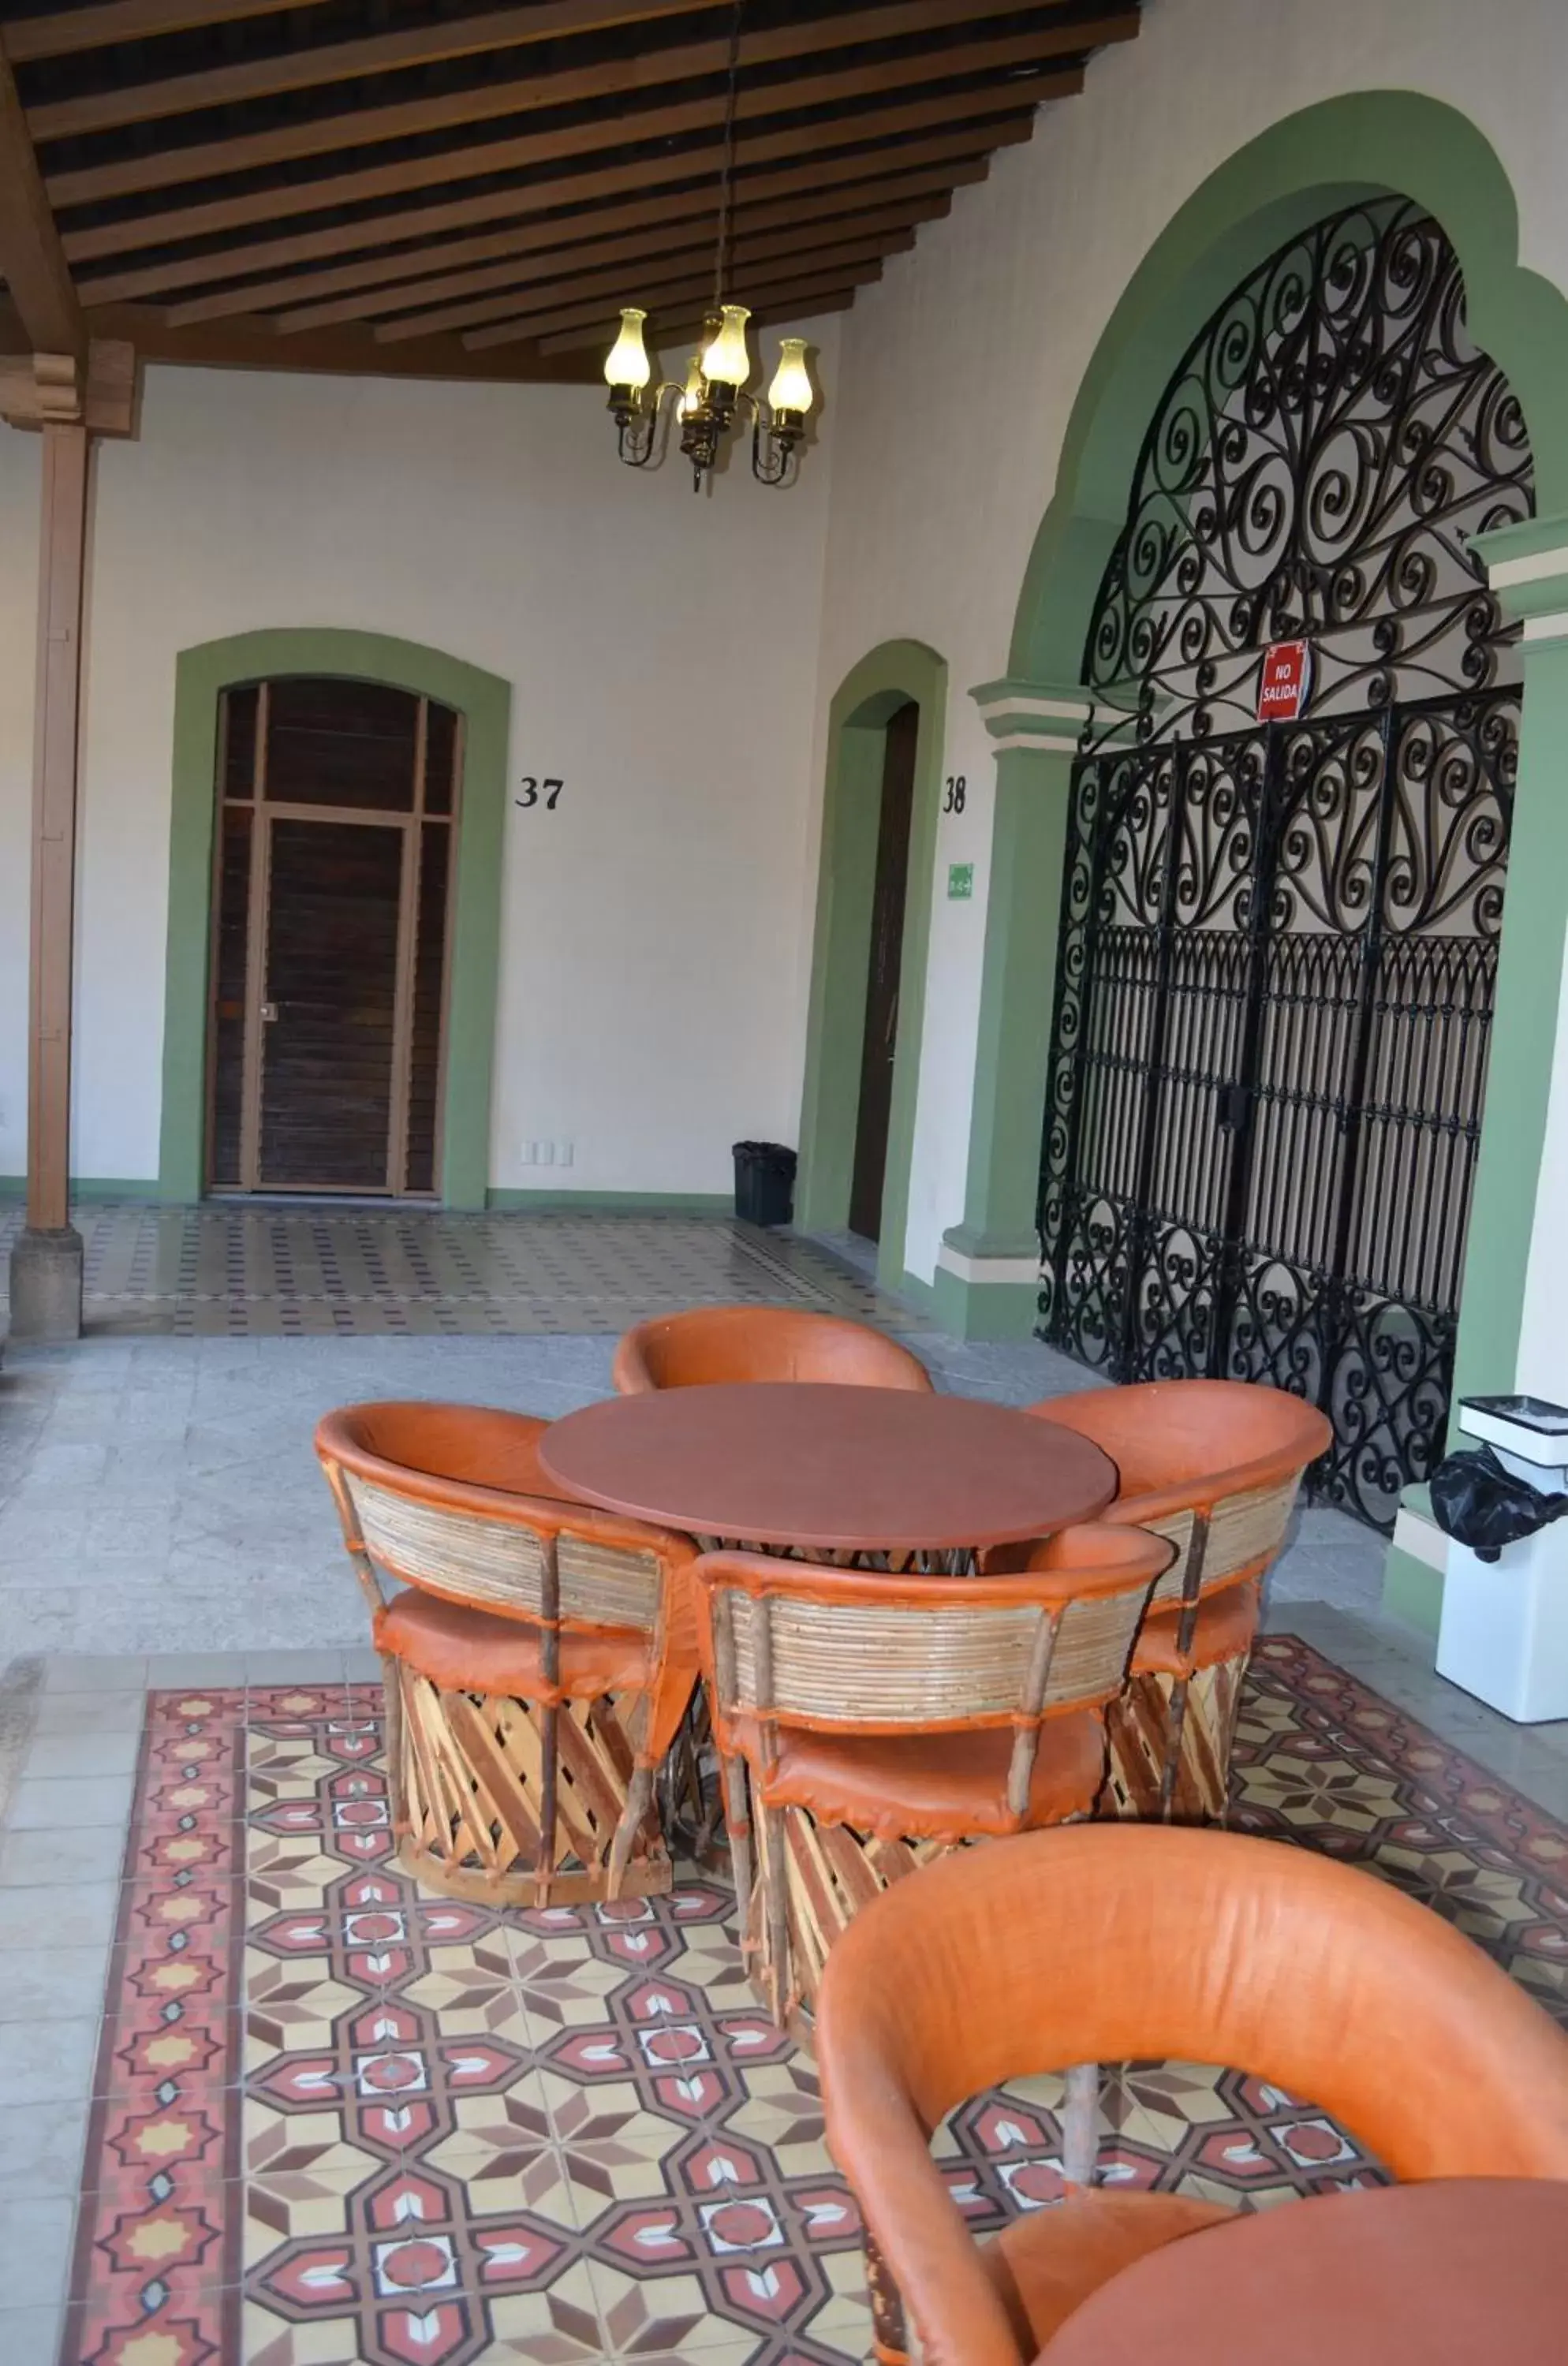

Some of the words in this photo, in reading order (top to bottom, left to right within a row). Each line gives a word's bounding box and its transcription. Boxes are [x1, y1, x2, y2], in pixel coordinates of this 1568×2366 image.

[1275, 663, 1291, 680] NO
[1263, 684, 1297, 702] SALIDA
[515, 777, 564, 811] 37
[943, 776, 966, 814] 38
